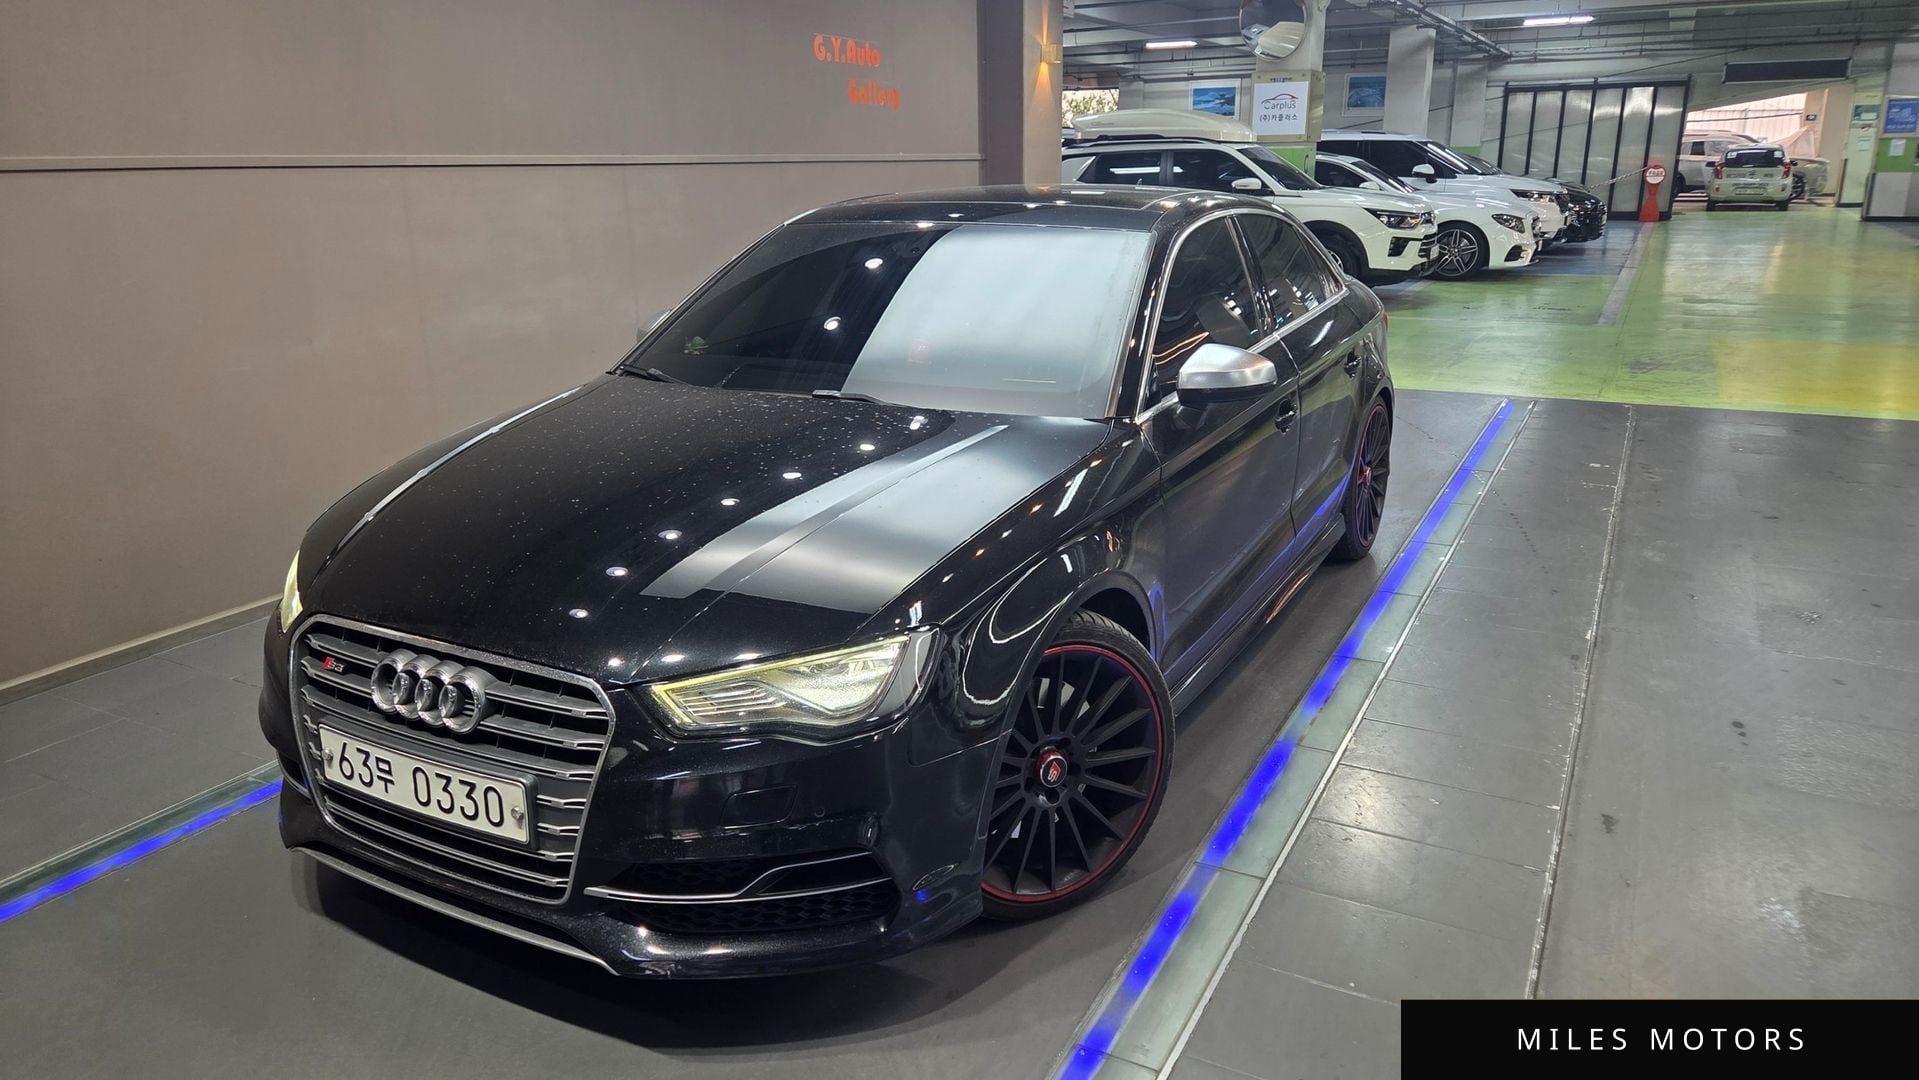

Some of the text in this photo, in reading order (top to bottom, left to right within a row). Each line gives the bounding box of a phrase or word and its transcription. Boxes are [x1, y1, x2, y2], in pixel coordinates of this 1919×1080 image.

[1263, 100, 1297, 110] Carplus
[338, 742, 505, 827] 63무 0330
